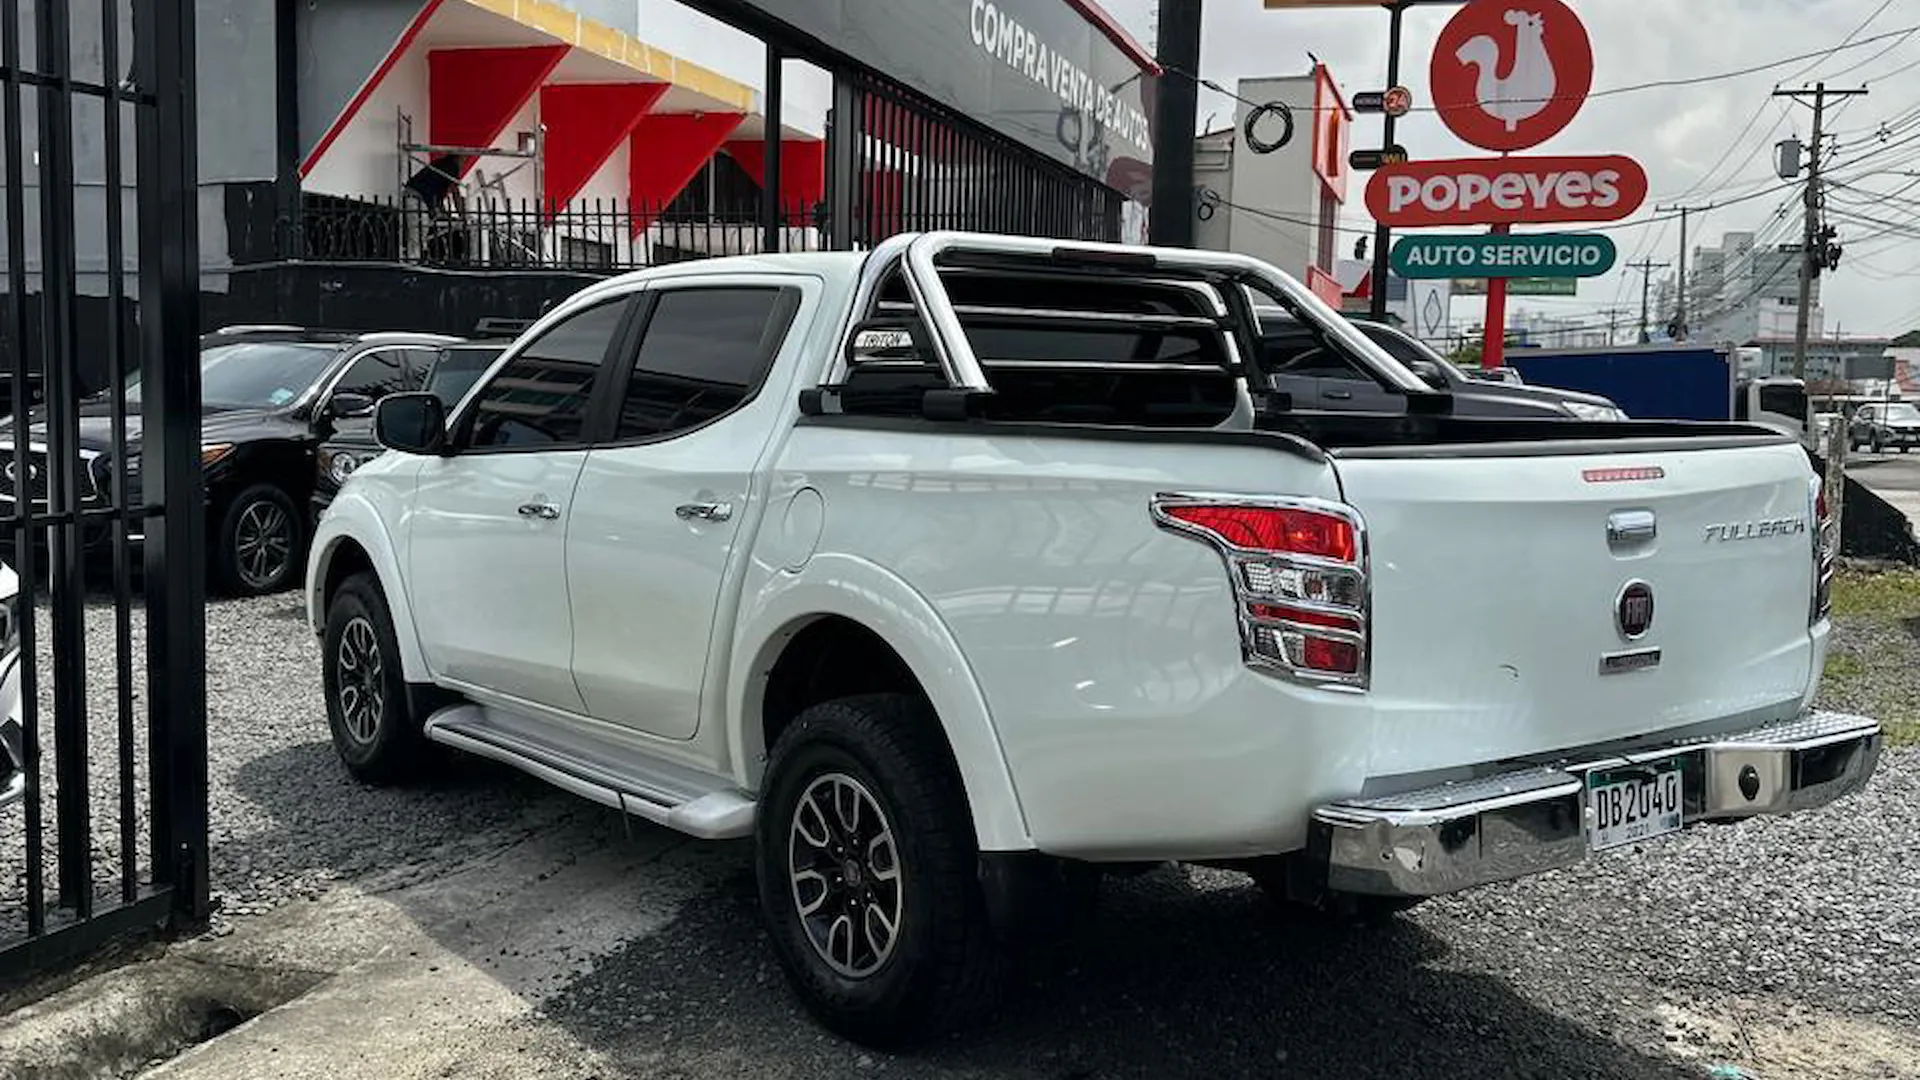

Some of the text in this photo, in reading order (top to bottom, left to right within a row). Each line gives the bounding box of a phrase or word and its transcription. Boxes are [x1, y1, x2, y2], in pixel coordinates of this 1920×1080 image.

[1112, 98, 1149, 151] AUTOS
[1406, 245, 1601, 266] AUTO SERVICIO
[1597, 774, 1677, 831] DB2040
